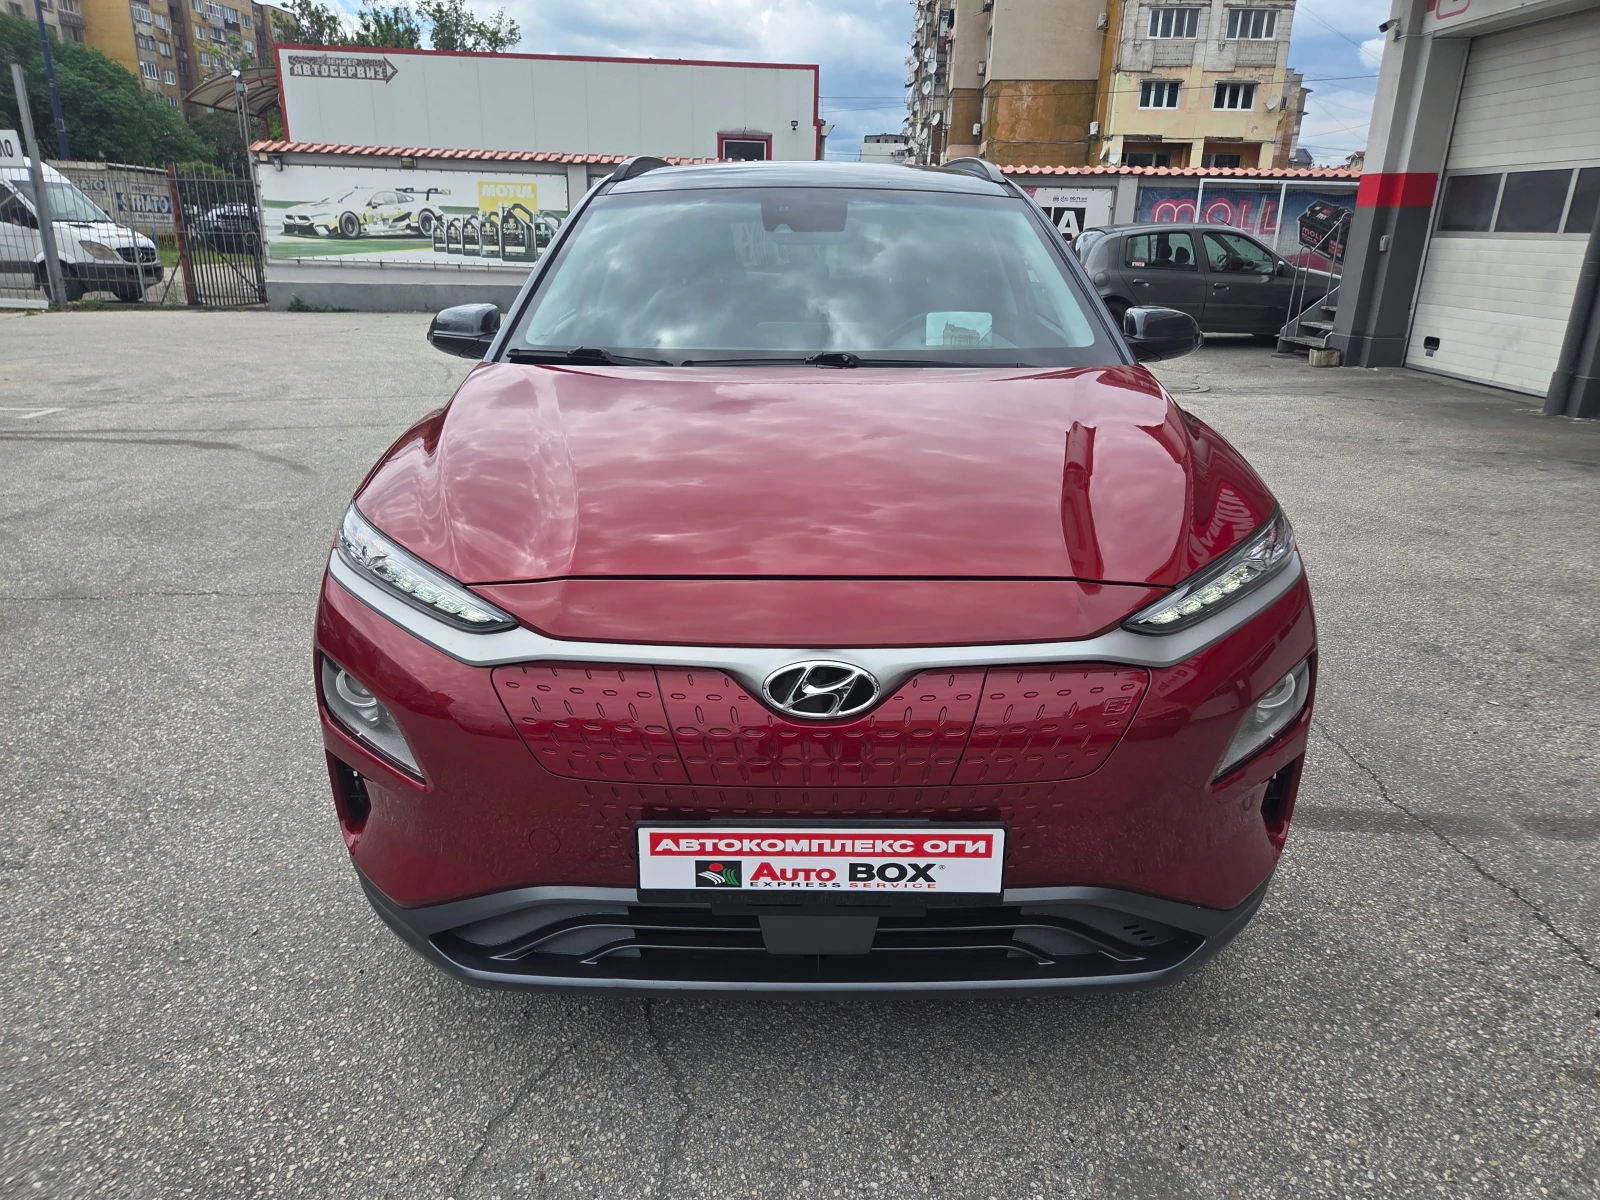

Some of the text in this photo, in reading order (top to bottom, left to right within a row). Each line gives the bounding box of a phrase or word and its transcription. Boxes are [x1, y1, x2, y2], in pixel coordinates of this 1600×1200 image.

[294, 63, 384, 79] АВТОСЕРВИЗ
[481, 184, 535, 199] MOTUL
[1151, 198, 1282, 235] MOLL
[654, 838, 987, 853] АВТОКОМПЛЕКС ОГИ
[749, 862, 837, 882] AUTO
